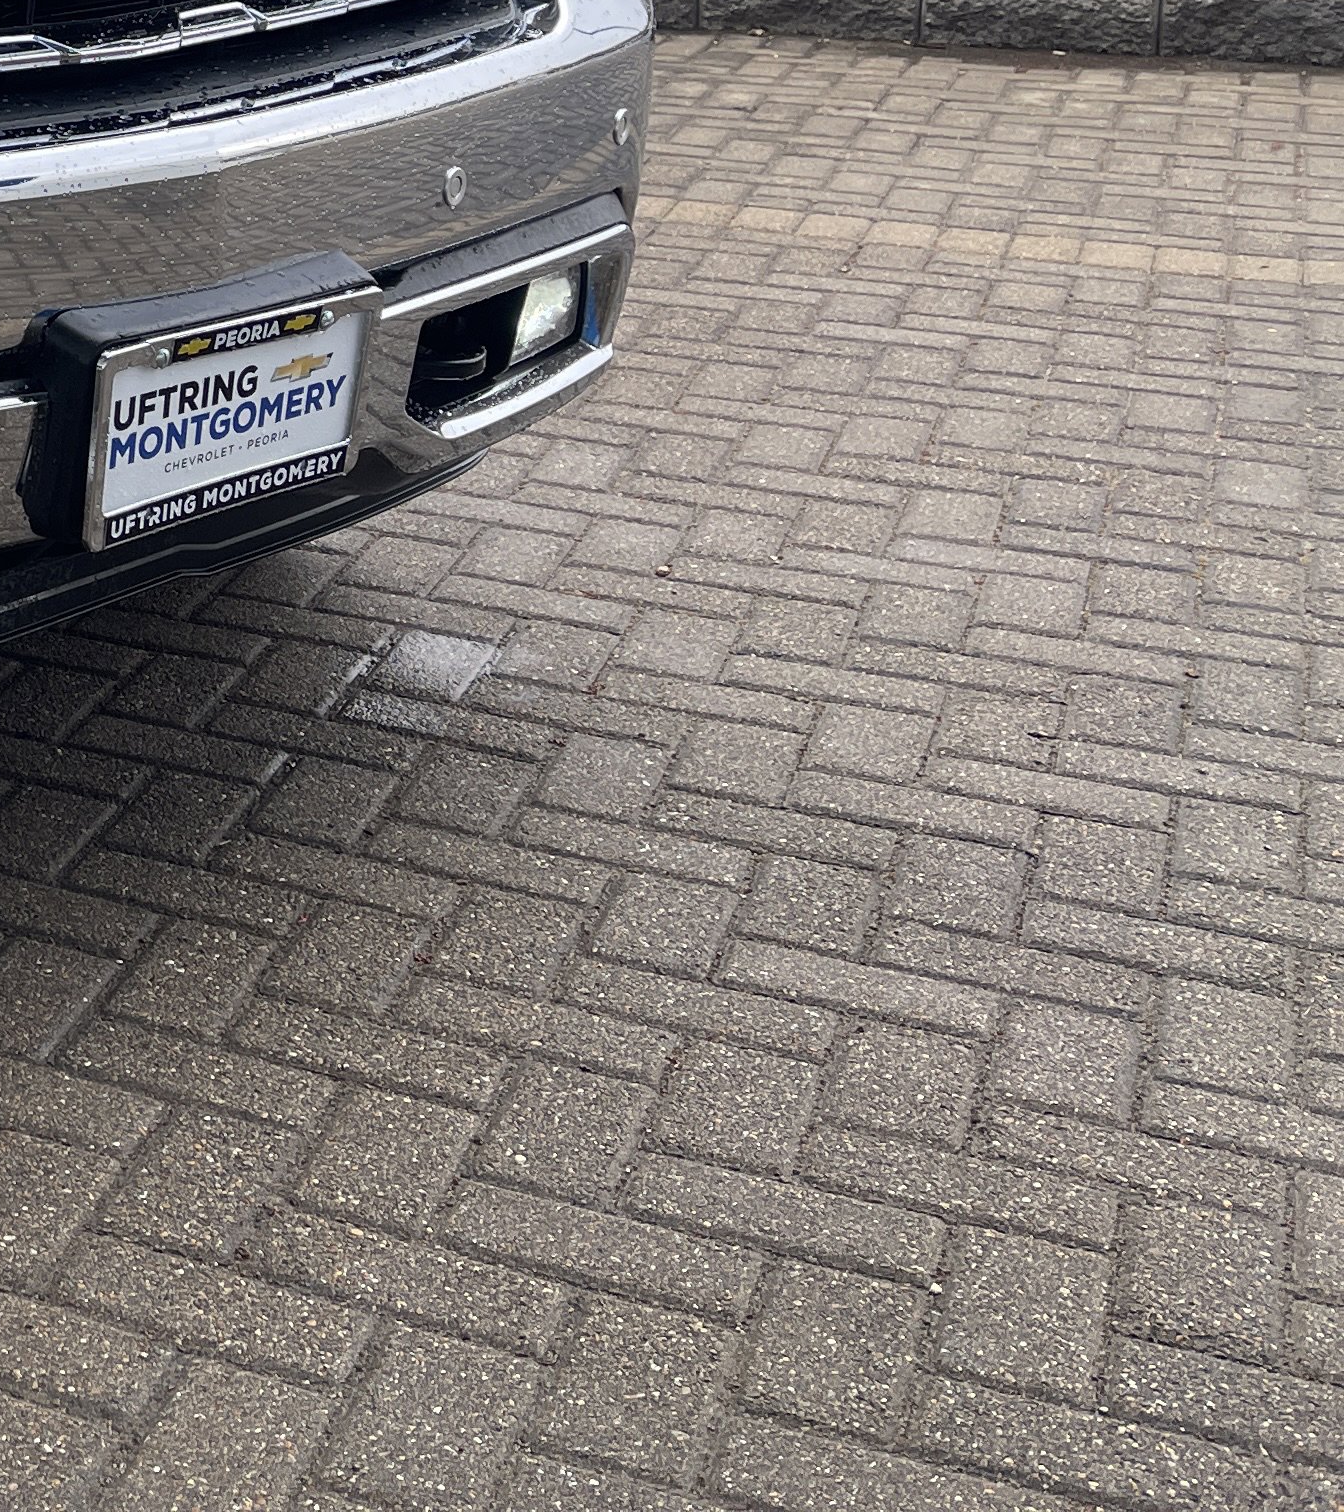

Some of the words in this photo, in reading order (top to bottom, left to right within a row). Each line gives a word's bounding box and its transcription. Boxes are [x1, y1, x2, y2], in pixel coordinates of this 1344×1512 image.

[213, 320, 280, 351] PEORIA
[108, 375, 347, 470] MONTGOMERY
[113, 364, 259, 431] UFTRING
[164, 445, 234, 473] CHEVROLET
[247, 430, 289, 451] PEORIA
[111, 495, 197, 538] UFTRING
[202, 451, 344, 508] MONTGOMERY
